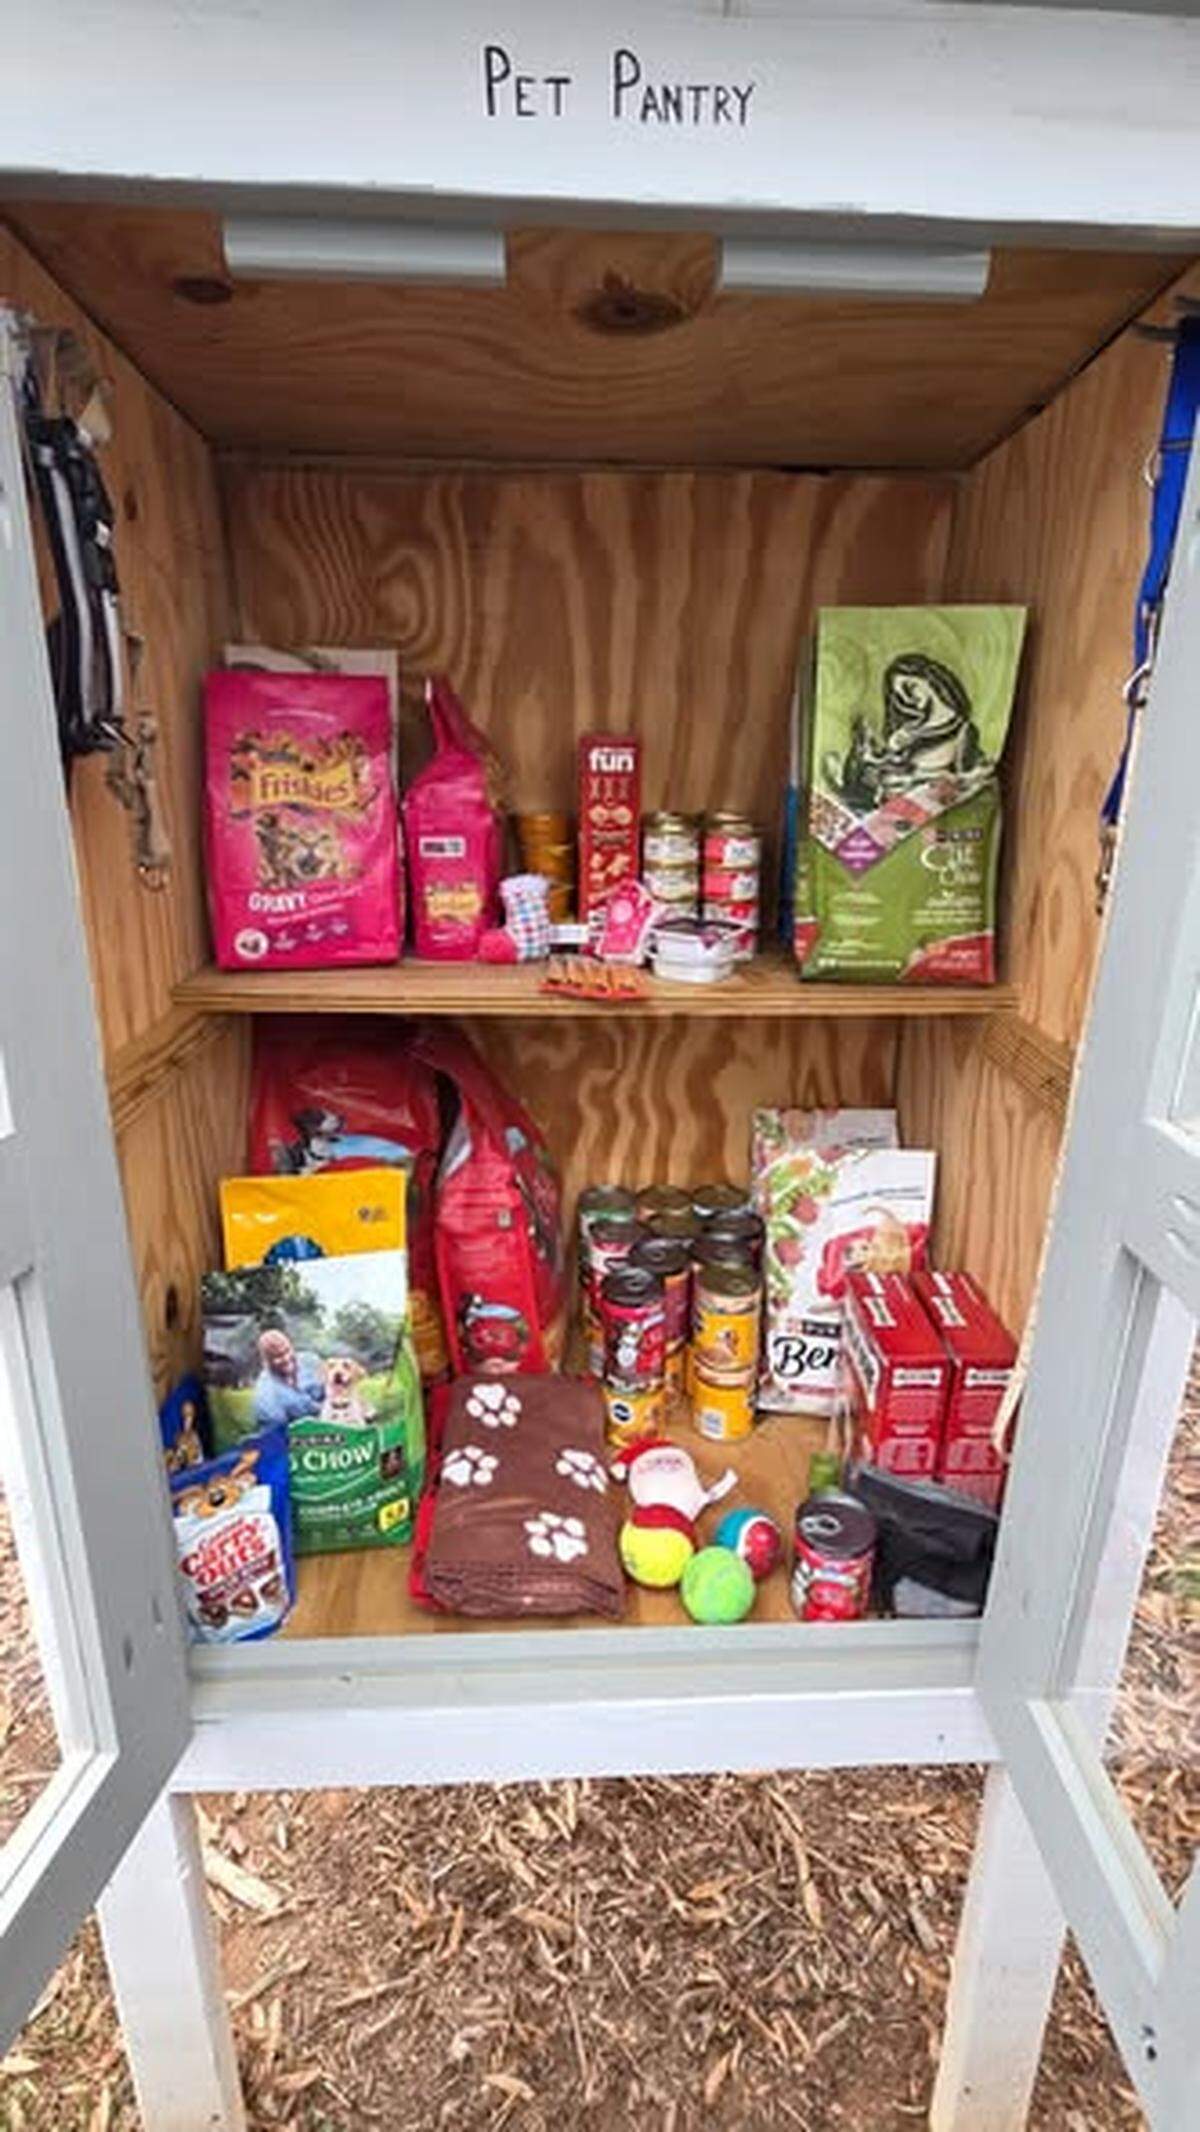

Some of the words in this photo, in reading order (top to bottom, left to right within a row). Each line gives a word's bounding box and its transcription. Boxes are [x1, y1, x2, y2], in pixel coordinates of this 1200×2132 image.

[589, 748, 634, 772] fun
[259, 769, 350, 803] Friskies
[301, 1441, 375, 1472] CHOW
